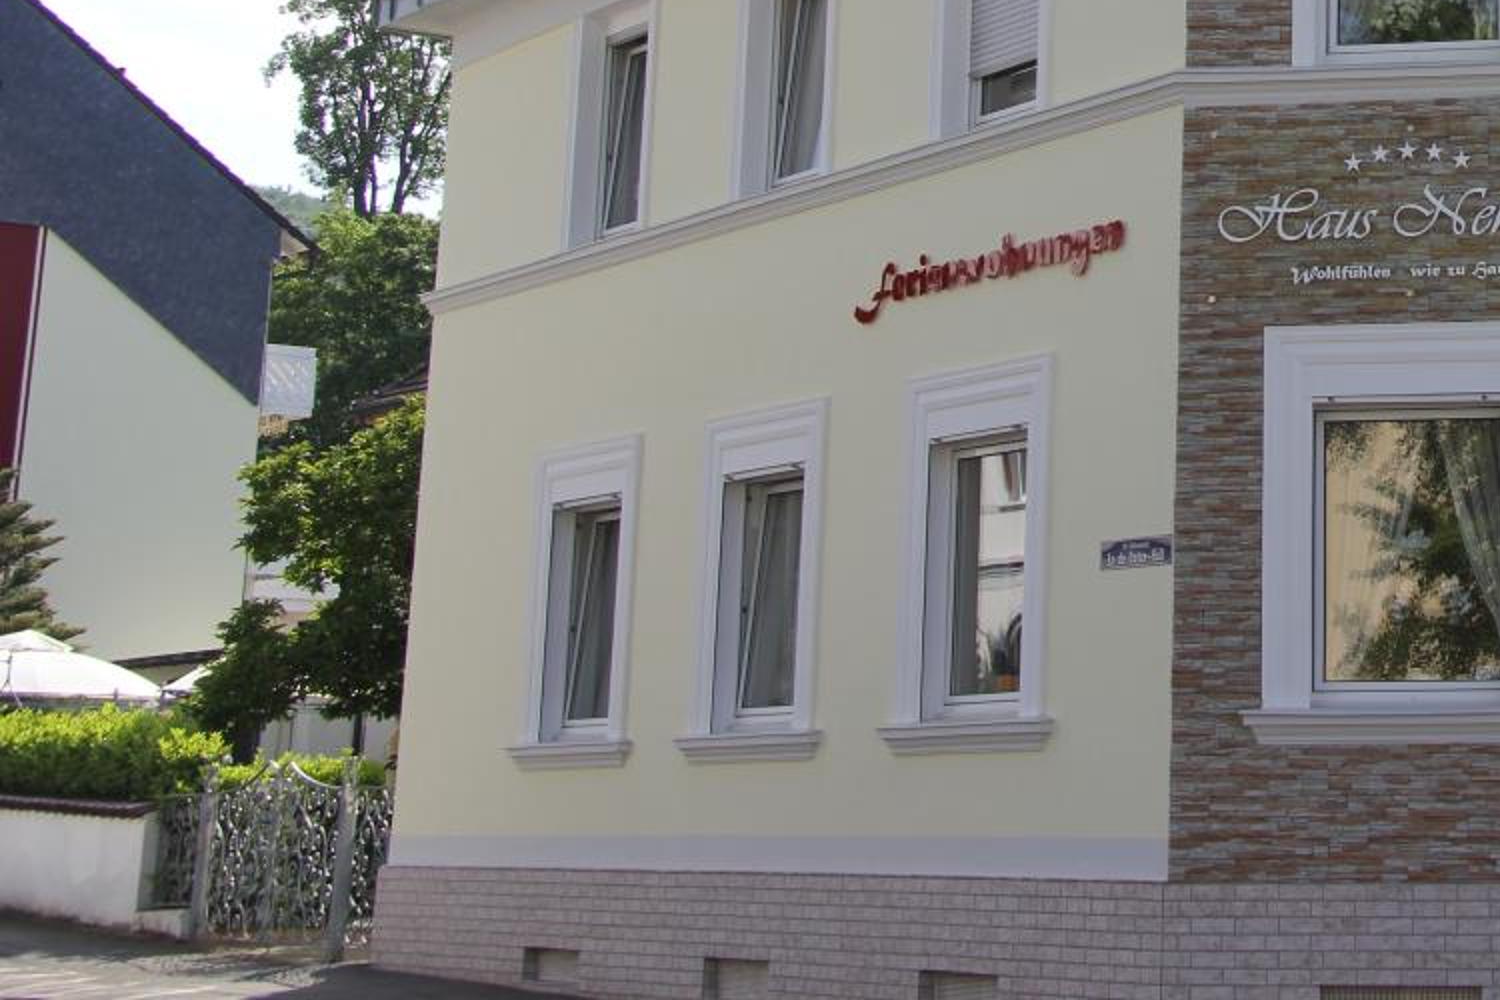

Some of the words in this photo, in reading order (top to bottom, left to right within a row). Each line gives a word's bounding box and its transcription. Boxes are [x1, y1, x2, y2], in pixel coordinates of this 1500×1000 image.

[1218, 189, 1377, 243] Haus
[854, 220, 1125, 324] Ferienwohnungen
[1290, 264, 1391, 285] Wohlfühlen
[1410, 263, 1441, 278] wie
[1449, 264, 1465, 277] zu
